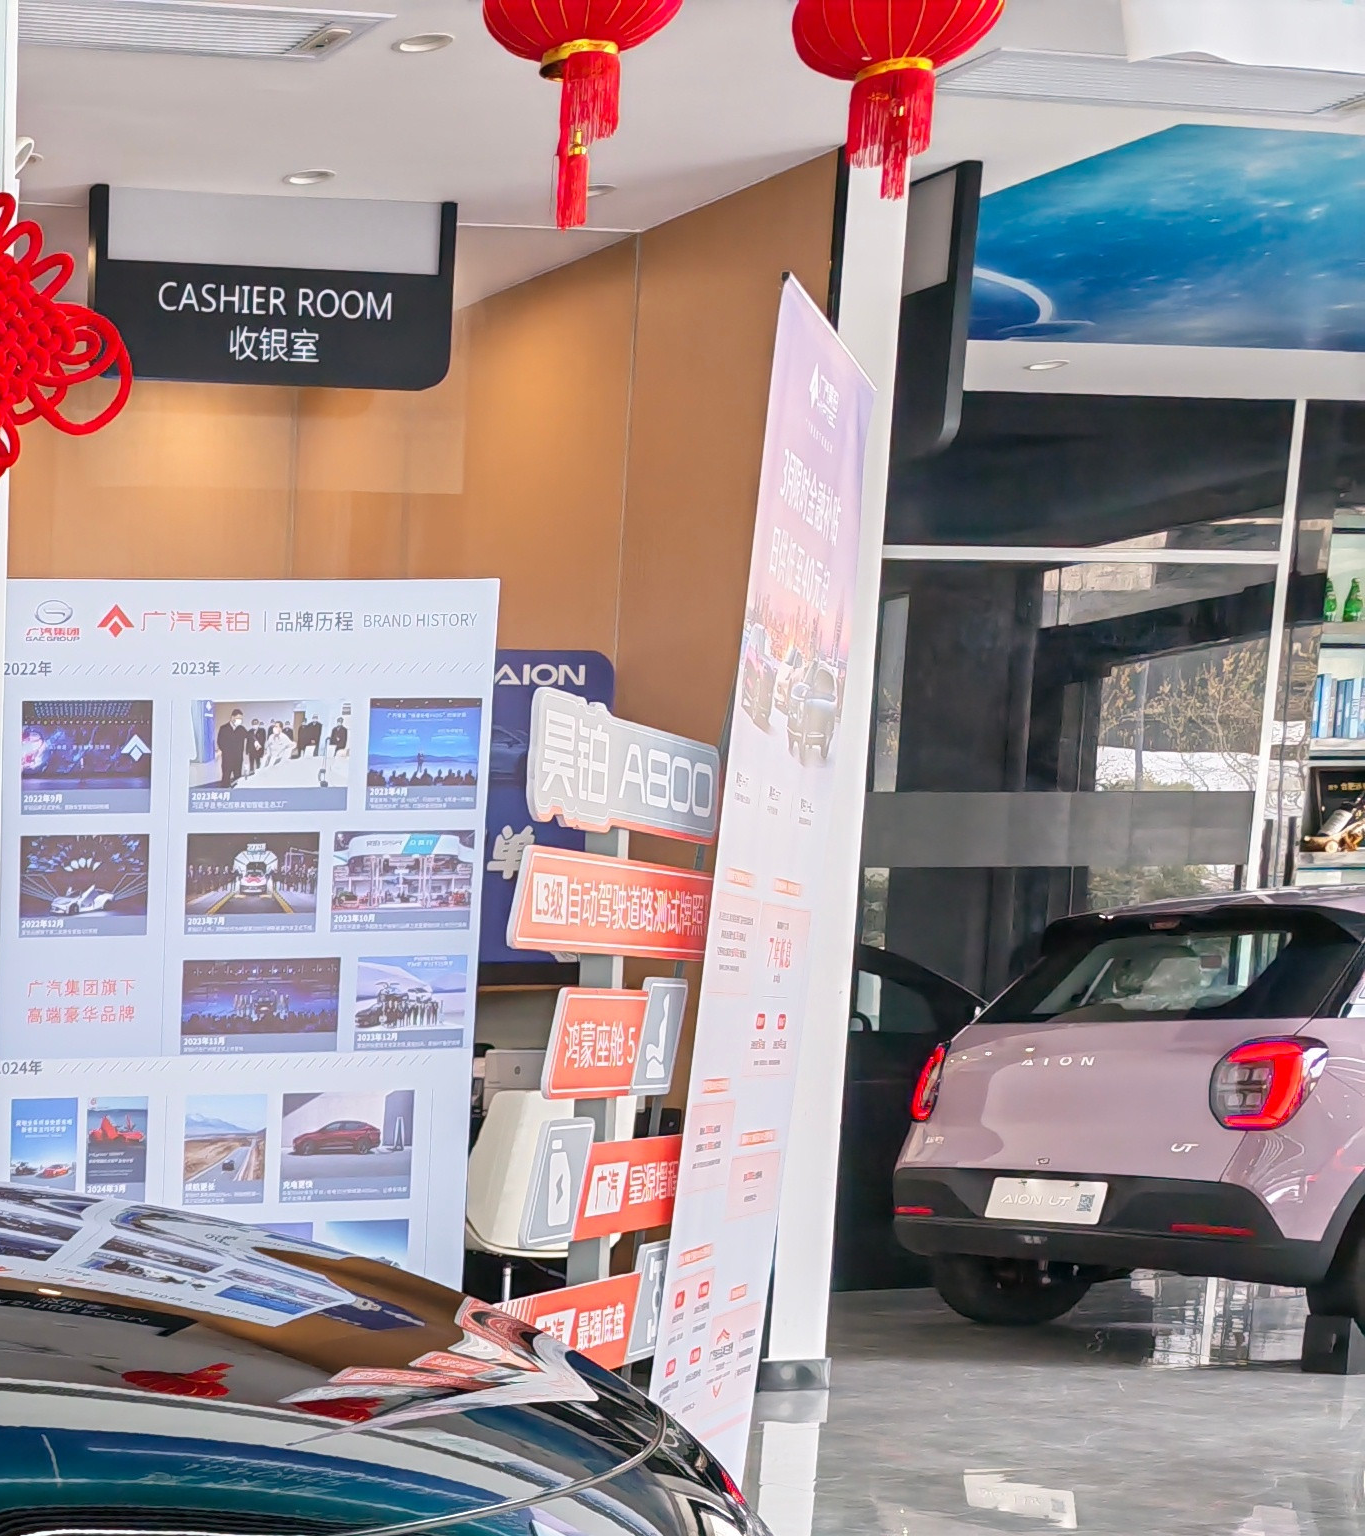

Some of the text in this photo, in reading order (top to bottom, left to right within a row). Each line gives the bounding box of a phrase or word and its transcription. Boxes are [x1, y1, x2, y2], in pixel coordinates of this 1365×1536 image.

[158, 281, 392, 320] CASHIER ROOM
[229, 325, 320, 363] 收银室
[140, 610, 478, 633] 广汽昊铂 品牌历程 BRAND HISTORY
[3, 660, 53, 677] 2022年
[171, 660, 221, 676] 2023年
[494, 663, 586, 686] AION
[541, 709, 713, 818] 昊铂 A800
[333, 913, 376, 923] 2023年10月
[27, 978, 136, 998] 广汽集团旗下
[27, 1005, 136, 1024] 高端豪华品牌
[562, 1020, 636, 1069] 鸿蒙座舱 5
[1021, 1056, 1095, 1066] AION
[1170, 1143, 1199, 1153] UT
[595, 1168, 620, 1209] 广汽
[999, 1193, 1072, 1207] AION UT
[576, 1302, 626, 1350] 最强底盘
